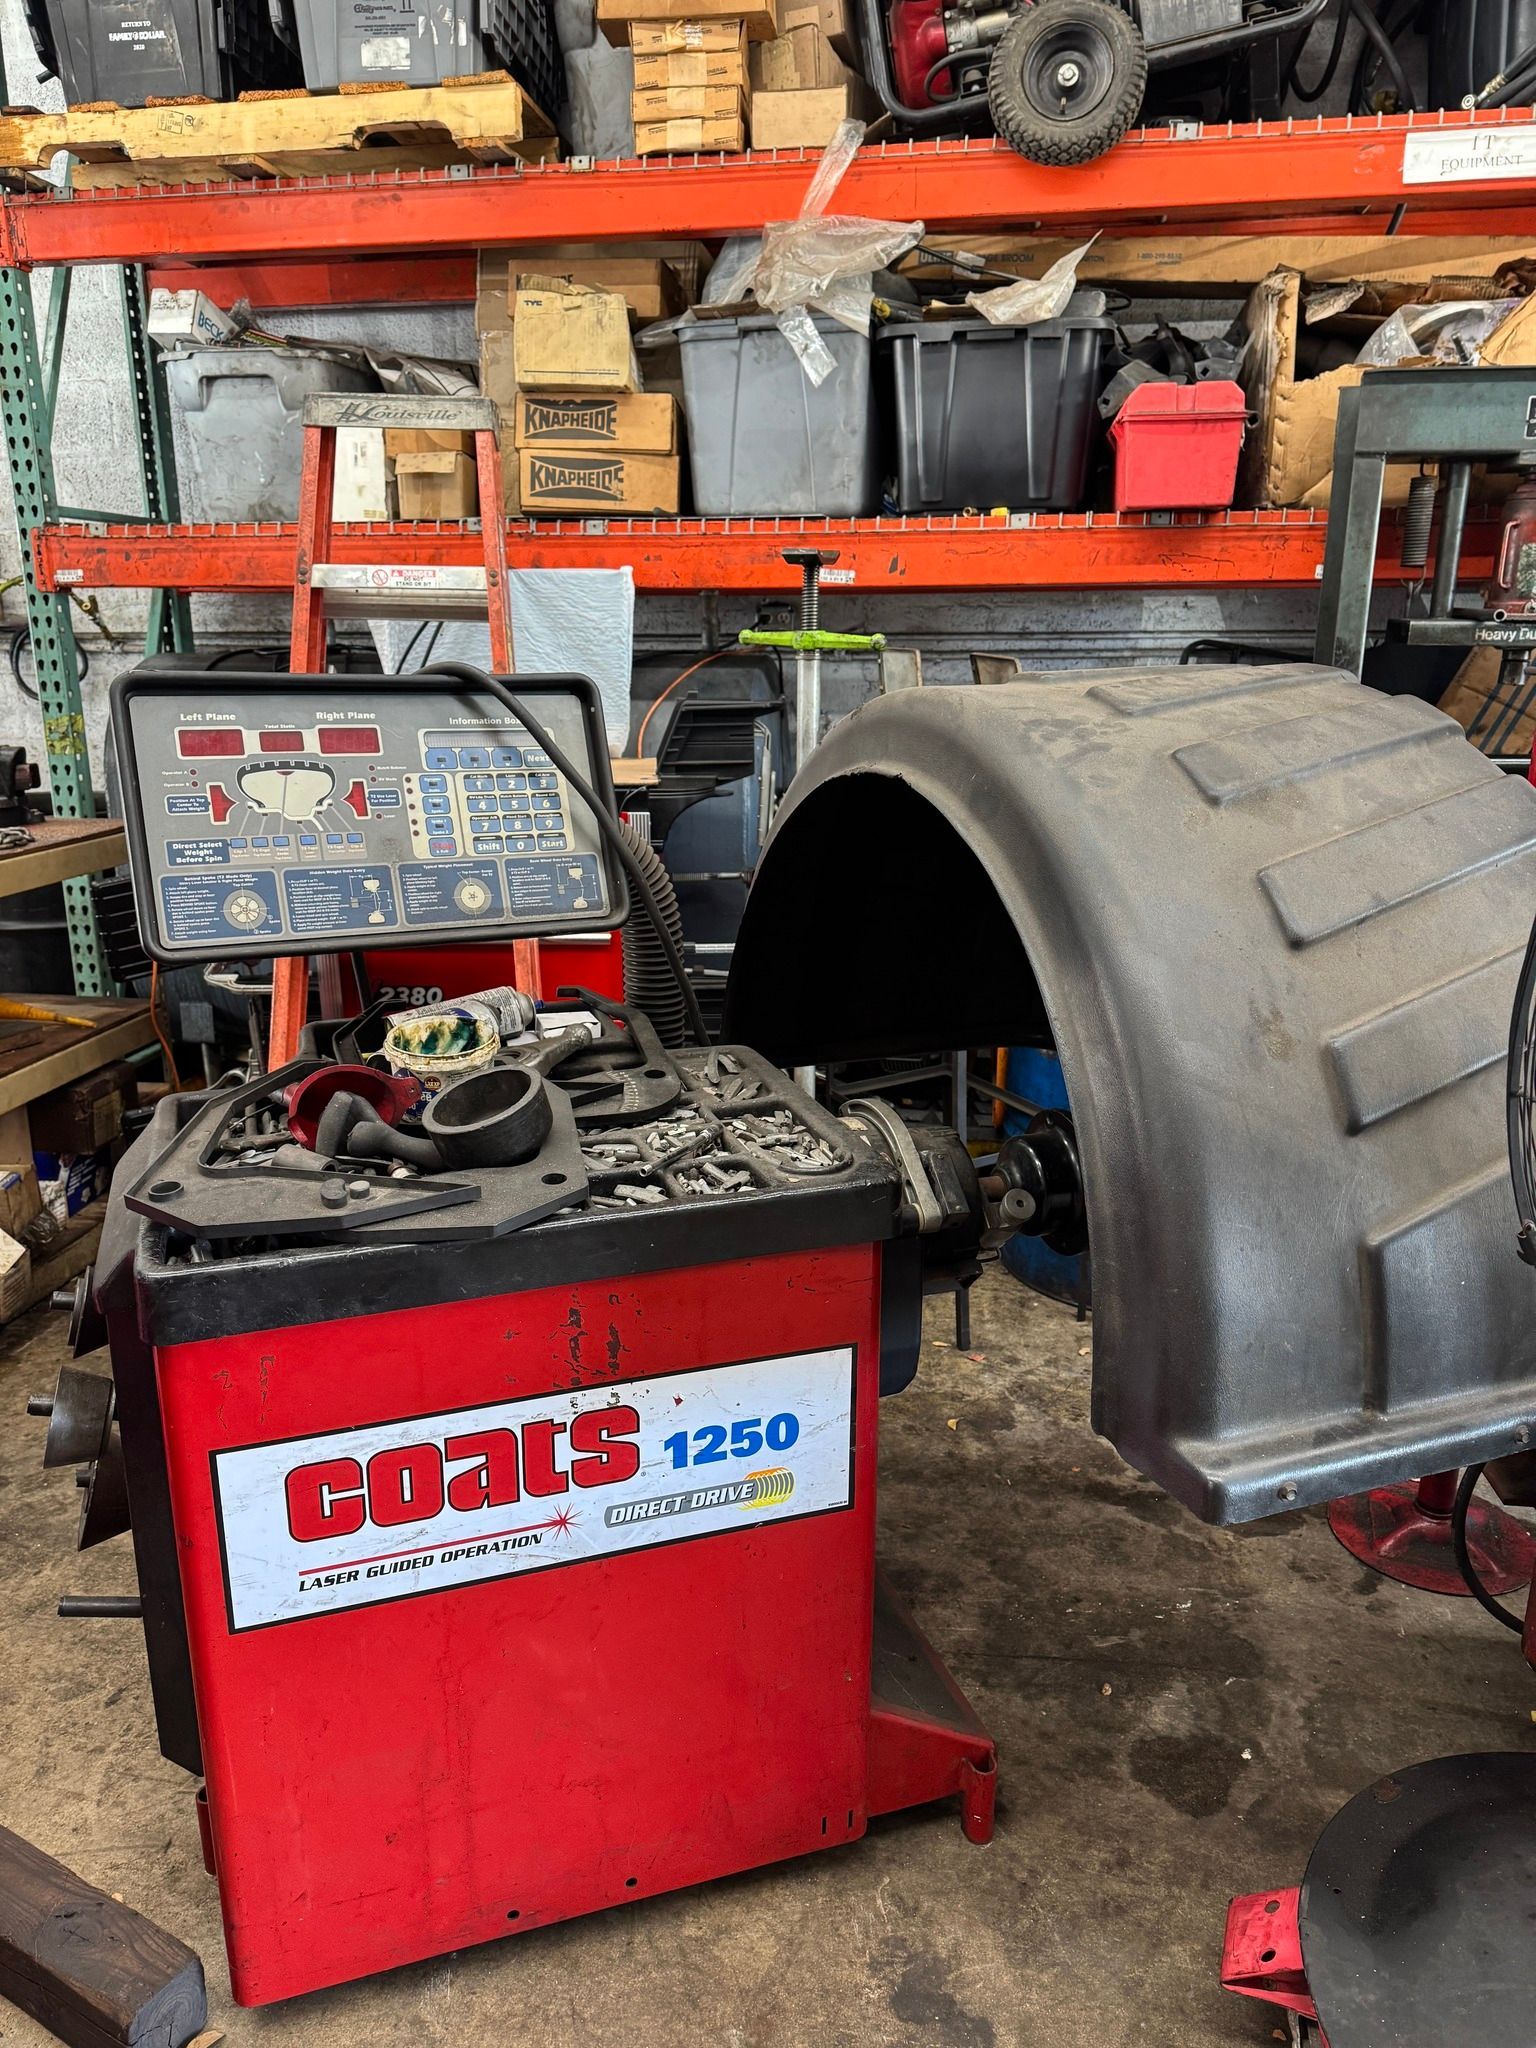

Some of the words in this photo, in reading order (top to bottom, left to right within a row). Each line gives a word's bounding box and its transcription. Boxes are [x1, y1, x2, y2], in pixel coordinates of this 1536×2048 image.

[108, 33, 133, 41] FAMILY
[139, 30, 166, 40] DOLLAR
[1440, 155, 1523, 176] EQUIPMENT
[197, 310, 224, 341] BECK
[355, 404, 457, 422] Louisville
[524, 402, 618, 436] KNAPHEIDE
[530, 459, 624, 496] KNAPHEIDE
[1475, 628, 1517, 642] Heavy
[1519, 627, 1536, 641] Du
[180, 713, 202, 721] Left
[206, 712, 236, 721] Plane
[316, 711, 344, 721] Right
[347, 711, 376, 720] Plane
[449, 717, 502, 725] Information
[475, 781, 482, 790] 1
[507, 780, 516, 789] 2
[539, 779, 548, 788] 3
[478, 801, 487, 810] 4
[511, 800, 519, 809] 5
[542, 799, 550, 808] 6
[481, 822, 489, 831] 7
[514, 821, 522, 830] 8
[545, 820, 553, 829] 9
[477, 843, 501, 852] Shift
[517, 842, 525, 850] 0
[541, 840, 564, 848] Start
[183, 848, 213, 857] Weight
[175, 856, 204, 864] Before
[205, 855, 223, 863] Spin
[379, 986, 443, 1006] 2380
[664, 1413, 799, 1470] 1250
[285, 1405, 640, 1543] coats
[609, 1495, 686, 1525] DIRECT
[690, 1481, 755, 1509] DRIVE
[299, 1569, 360, 1592] LASER
[366, 1554, 434, 1578] GUIDED
[440, 1532, 543, 1564] OPERATION
